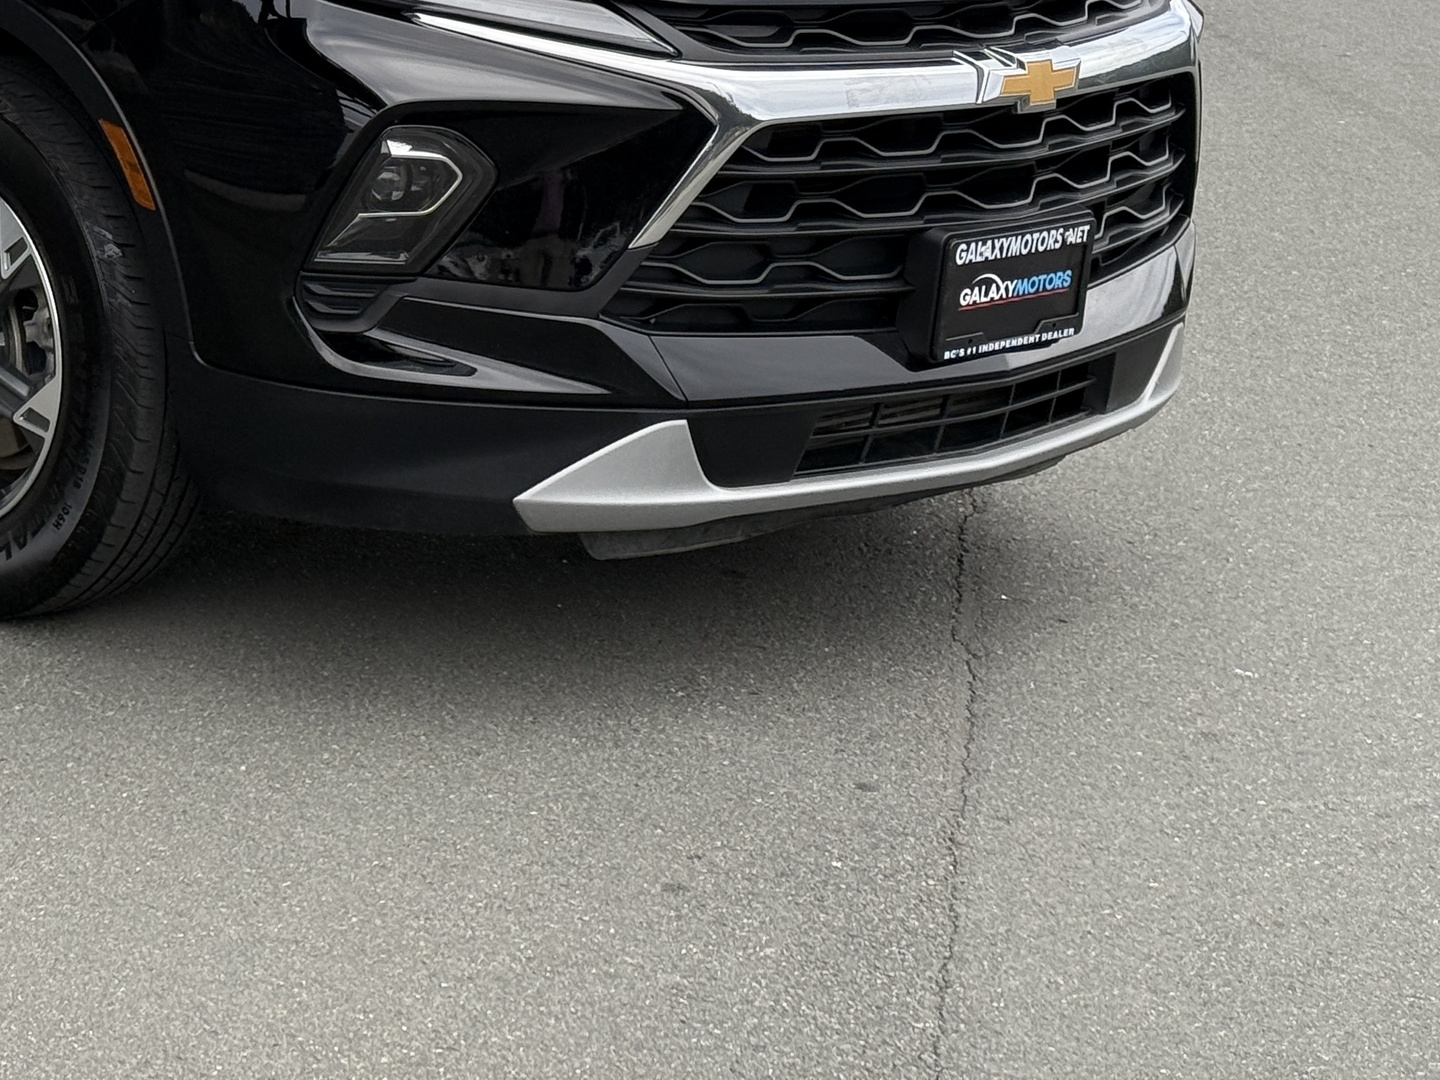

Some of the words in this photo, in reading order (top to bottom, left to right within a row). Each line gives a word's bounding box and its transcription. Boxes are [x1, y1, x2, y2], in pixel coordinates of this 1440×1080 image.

[955, 227, 1064, 266] GALAXYMOTORS
[959, 269, 1073, 307] GALAXYMOTORS
[943, 347, 965, 360] BC'S
[978, 333, 1041, 354] INDEPENDENT
[1041, 327, 1075, 342] DEALER
[51, 503, 73, 532] 106H
